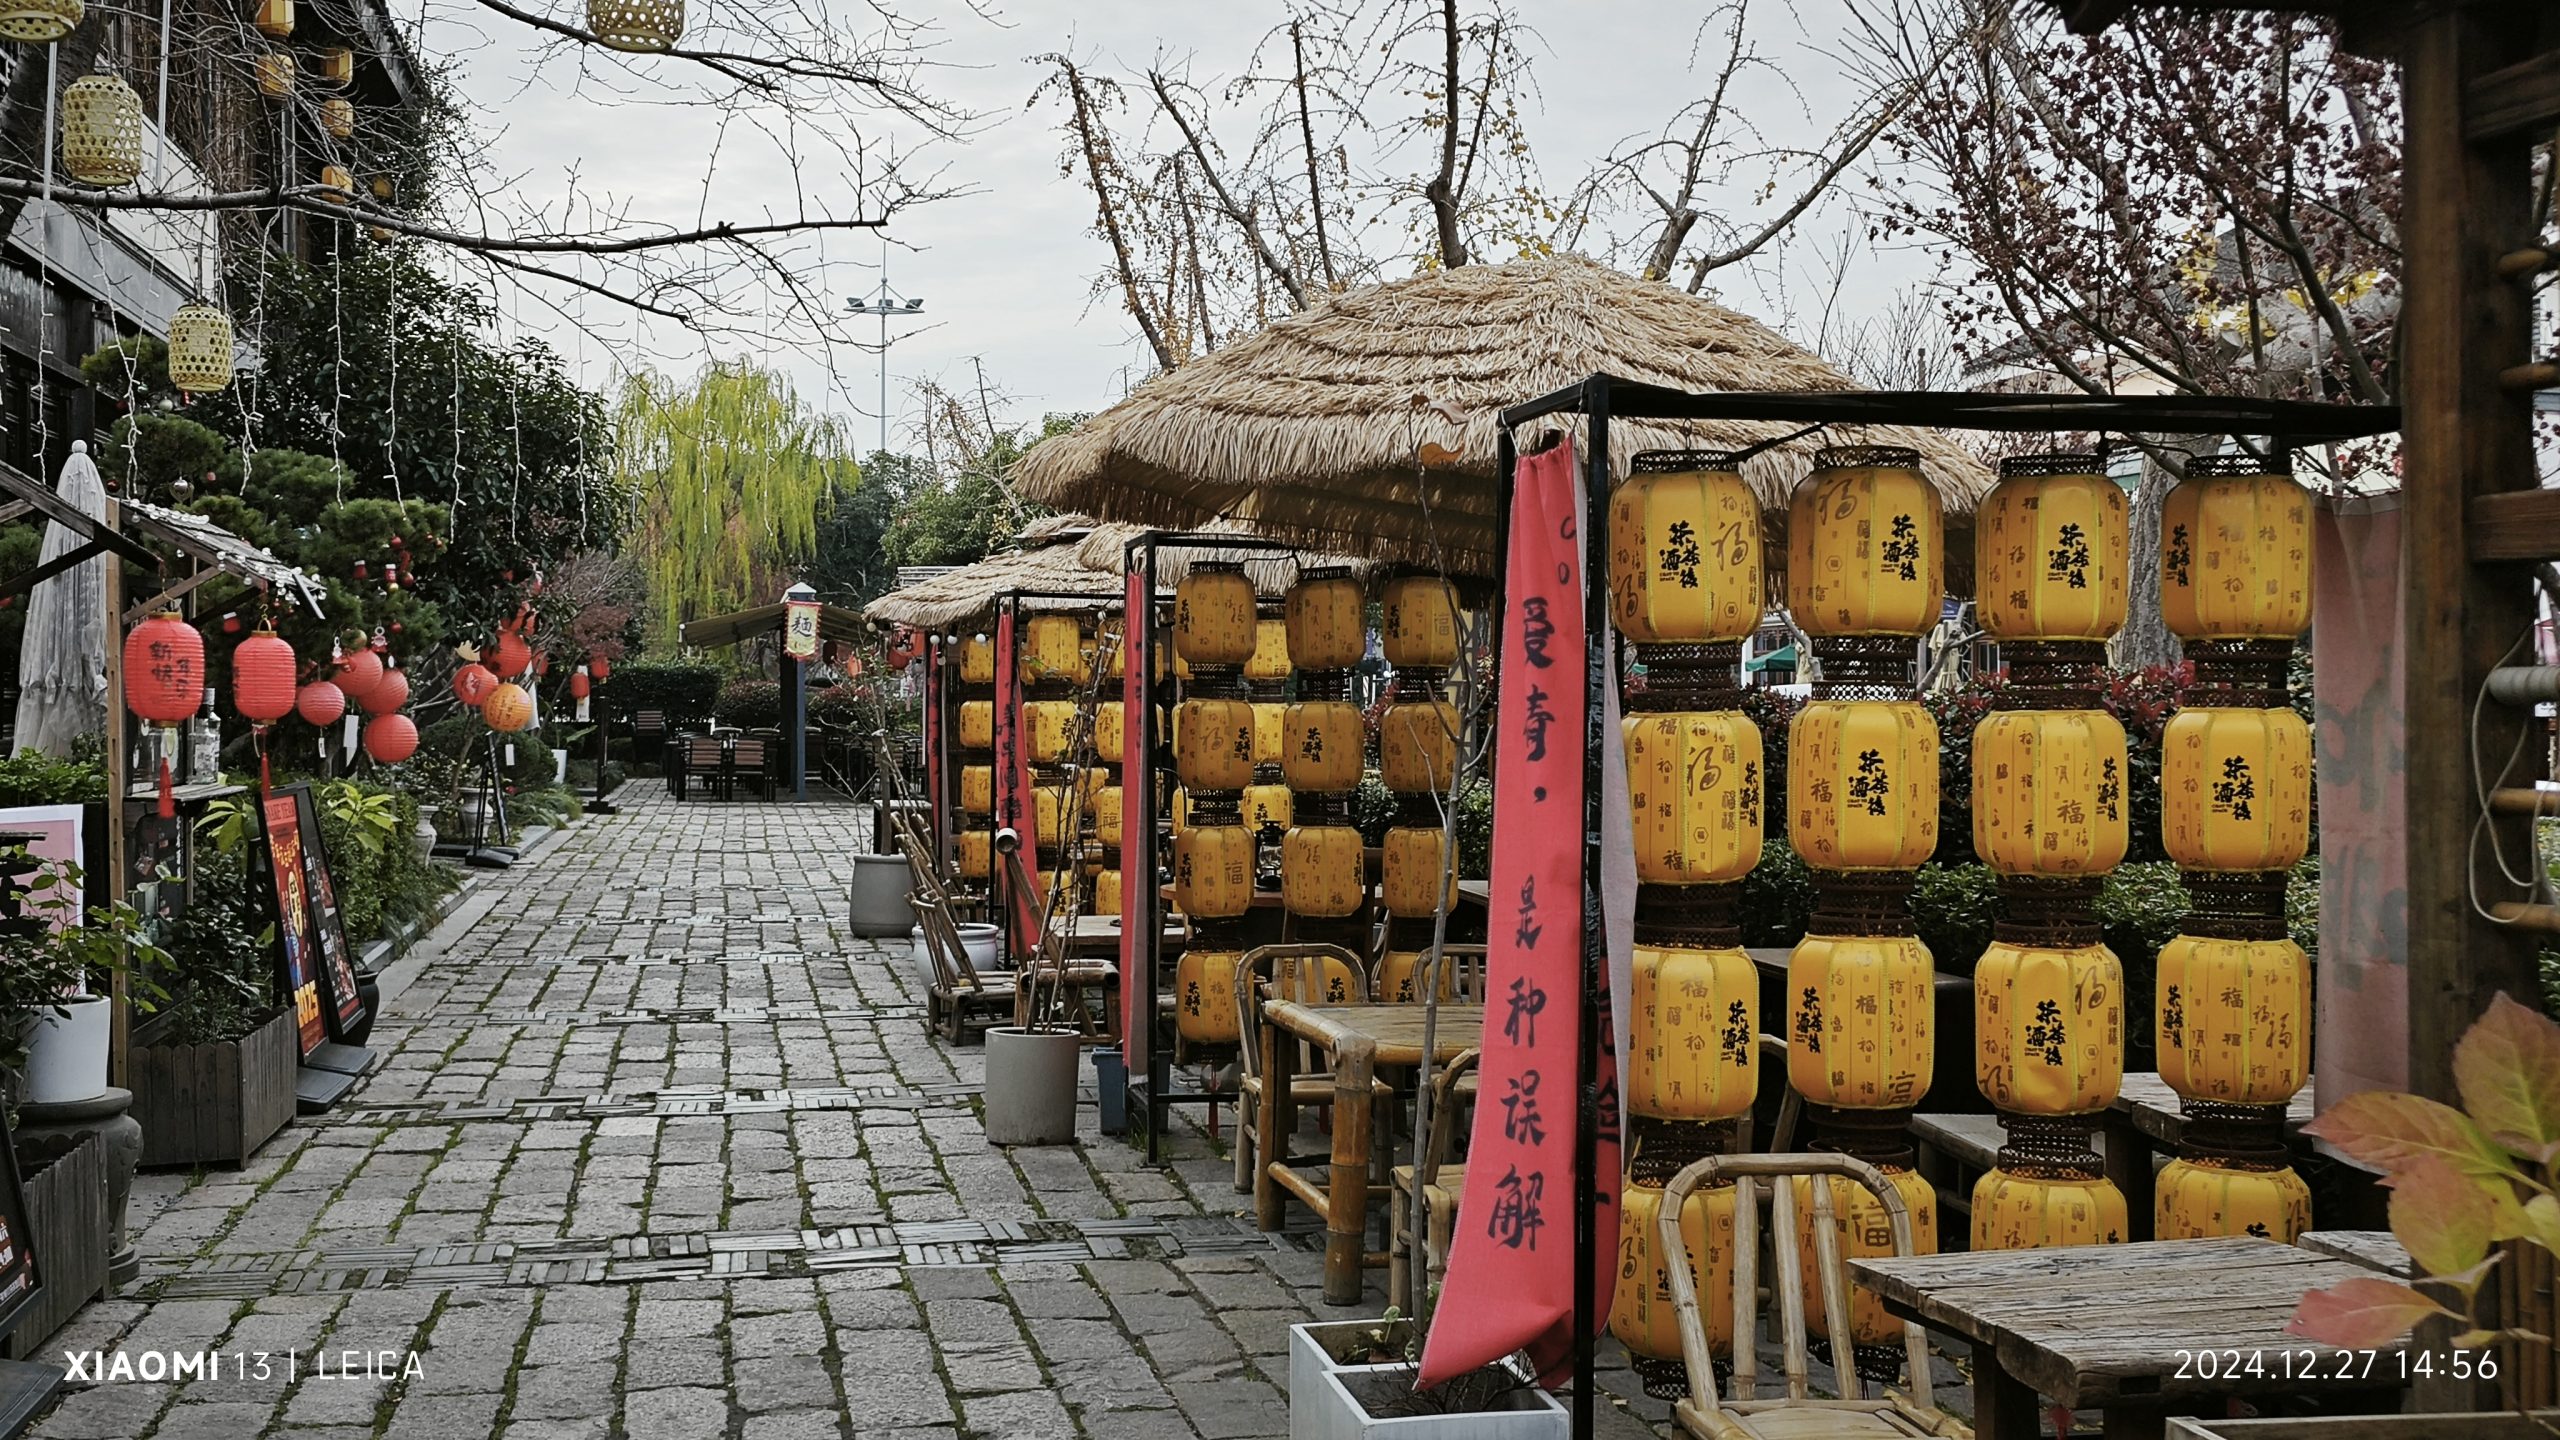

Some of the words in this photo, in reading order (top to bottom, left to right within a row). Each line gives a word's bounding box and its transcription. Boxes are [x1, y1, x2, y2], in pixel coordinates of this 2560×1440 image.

[1811, 778, 1832, 803] 福
[2057, 799, 2085, 825] 福
[294, 980, 319, 1029] 2025
